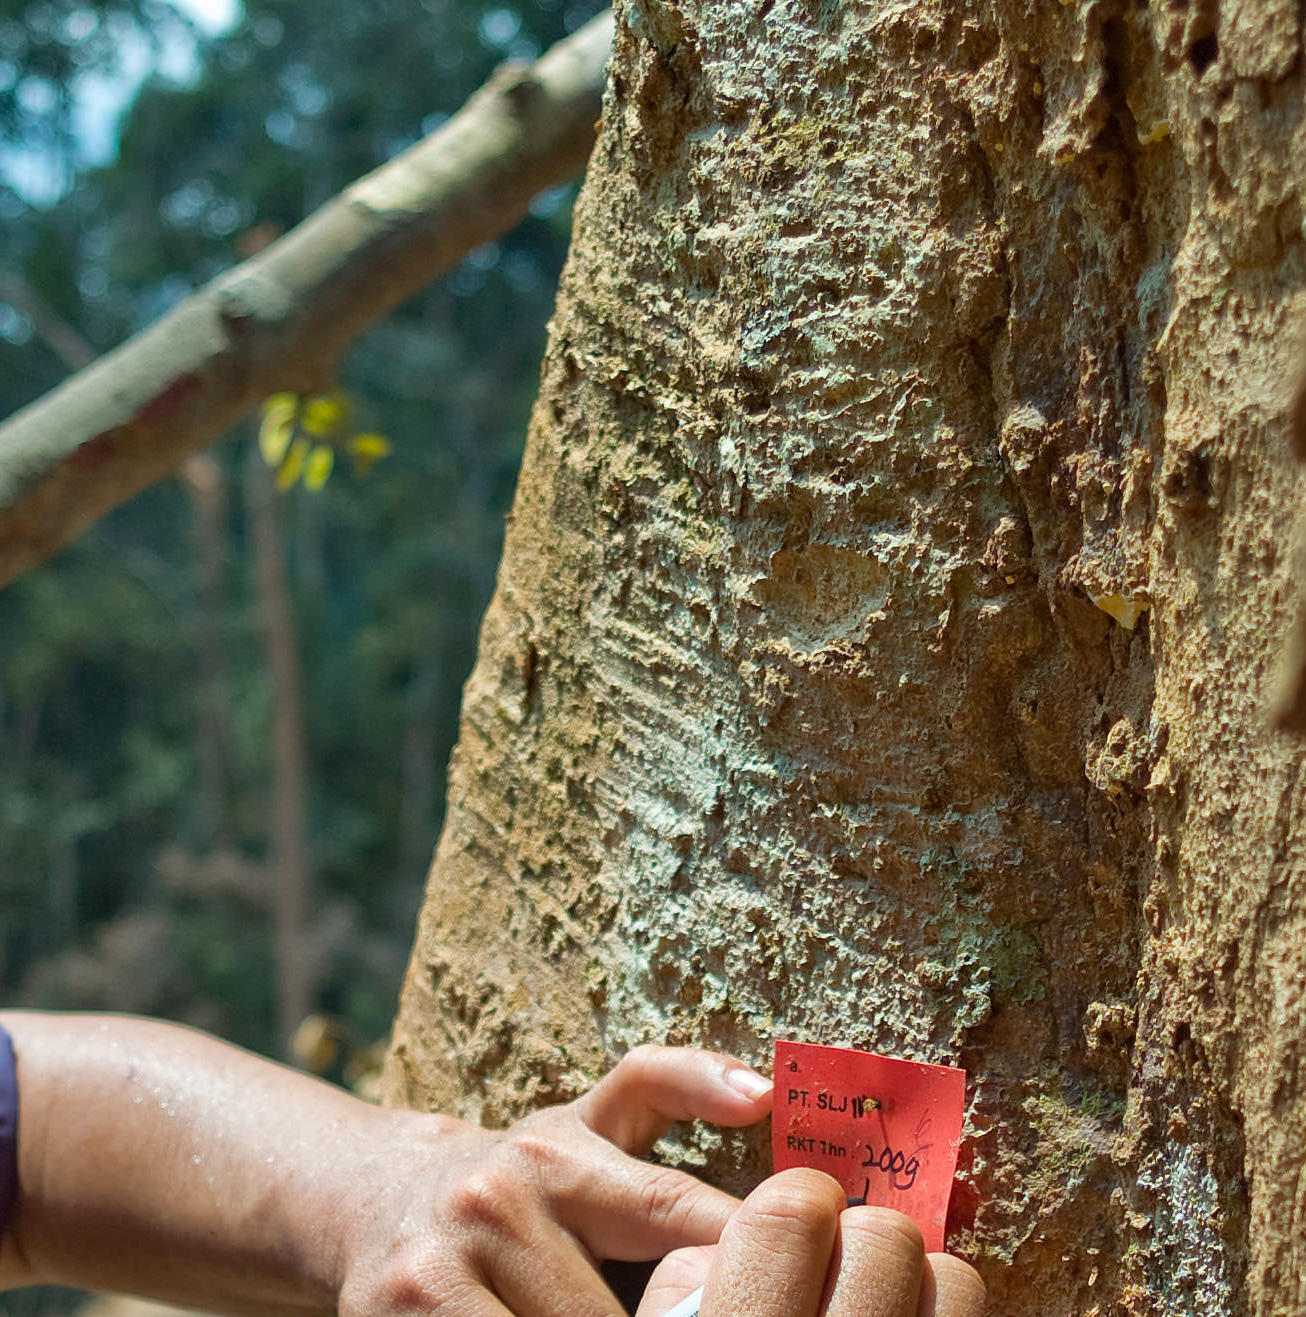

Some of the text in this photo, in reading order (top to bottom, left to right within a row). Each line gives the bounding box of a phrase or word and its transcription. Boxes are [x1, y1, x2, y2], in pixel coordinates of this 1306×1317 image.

[787, 1089, 811, 1108] PT.
[817, 1093, 848, 1112] SLJ
[786, 1135, 816, 1153] RKT
[861, 1143, 920, 1190] 2009
